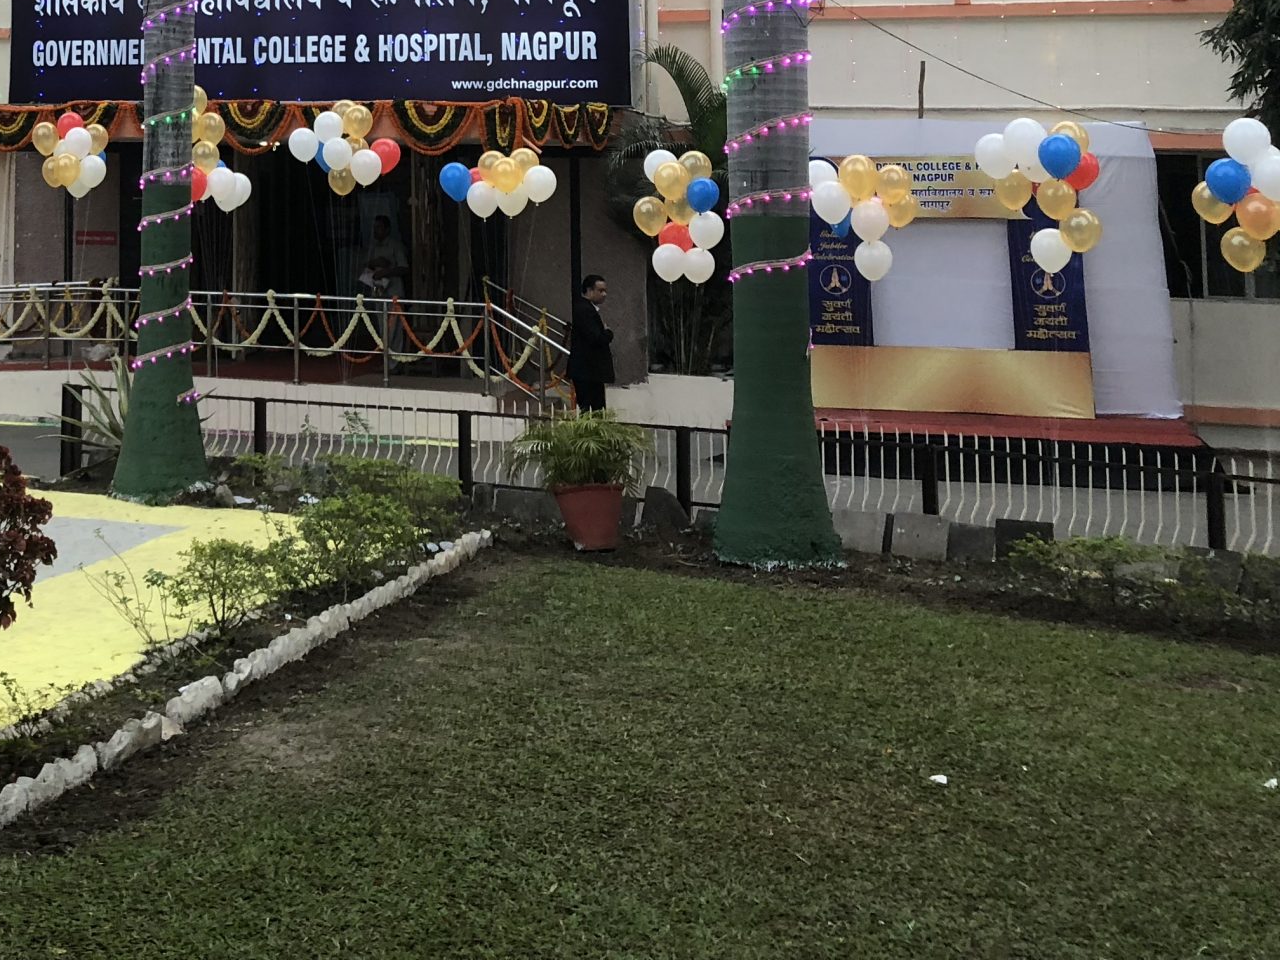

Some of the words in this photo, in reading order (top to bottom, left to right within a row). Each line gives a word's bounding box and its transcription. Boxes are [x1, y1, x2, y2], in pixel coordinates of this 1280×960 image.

[253, 34, 347, 65] COLLEGE
[353, 34, 370, 63] &
[378, 32, 493, 66] HOSPITAL,
[500, 31, 598, 60] NAGPUR
[451, 77, 599, 92] www.gdchnagpur.com
[916, 162, 961, 171] COLLEGE
[964, 162, 972, 171] &
[913, 173, 955, 182] NAGPUR
